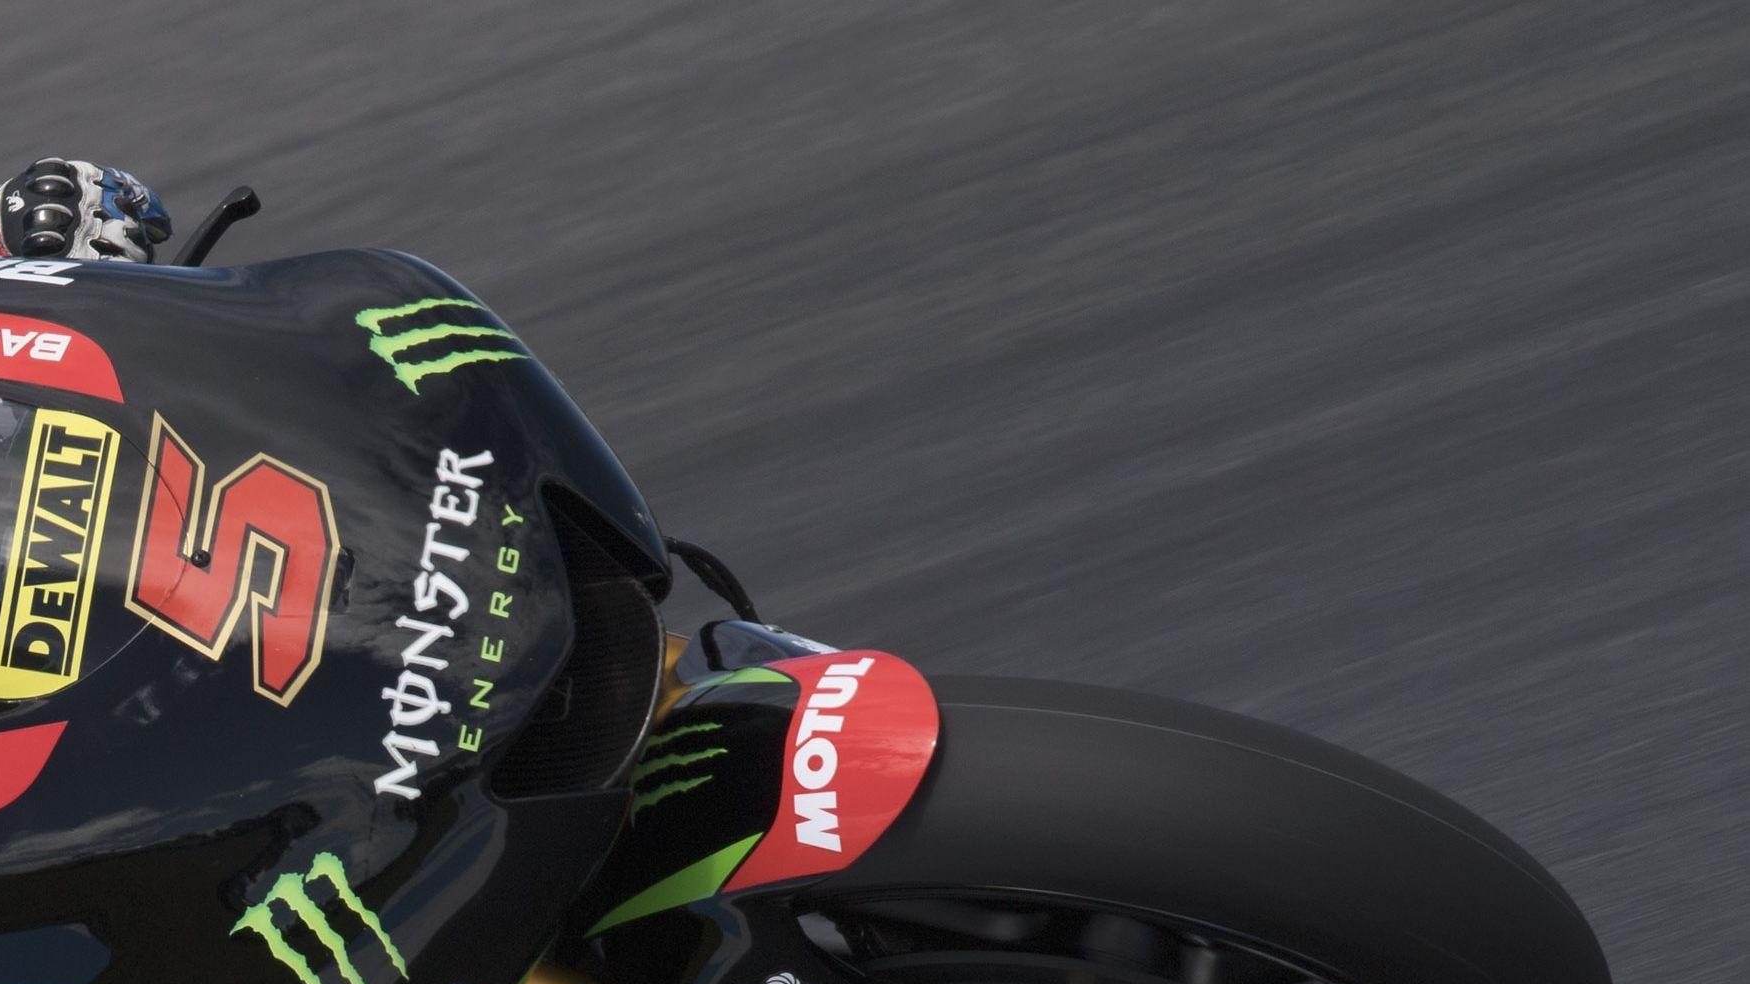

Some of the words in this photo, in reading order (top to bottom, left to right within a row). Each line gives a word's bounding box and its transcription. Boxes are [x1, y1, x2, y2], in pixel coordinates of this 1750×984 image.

[8, 424, 103, 676] DEWALT
[124, 409, 342, 707] 5
[373, 447, 495, 799] MONSTER
[458, 503, 524, 752] ENERGY
[792, 656, 875, 853] MOTUL
